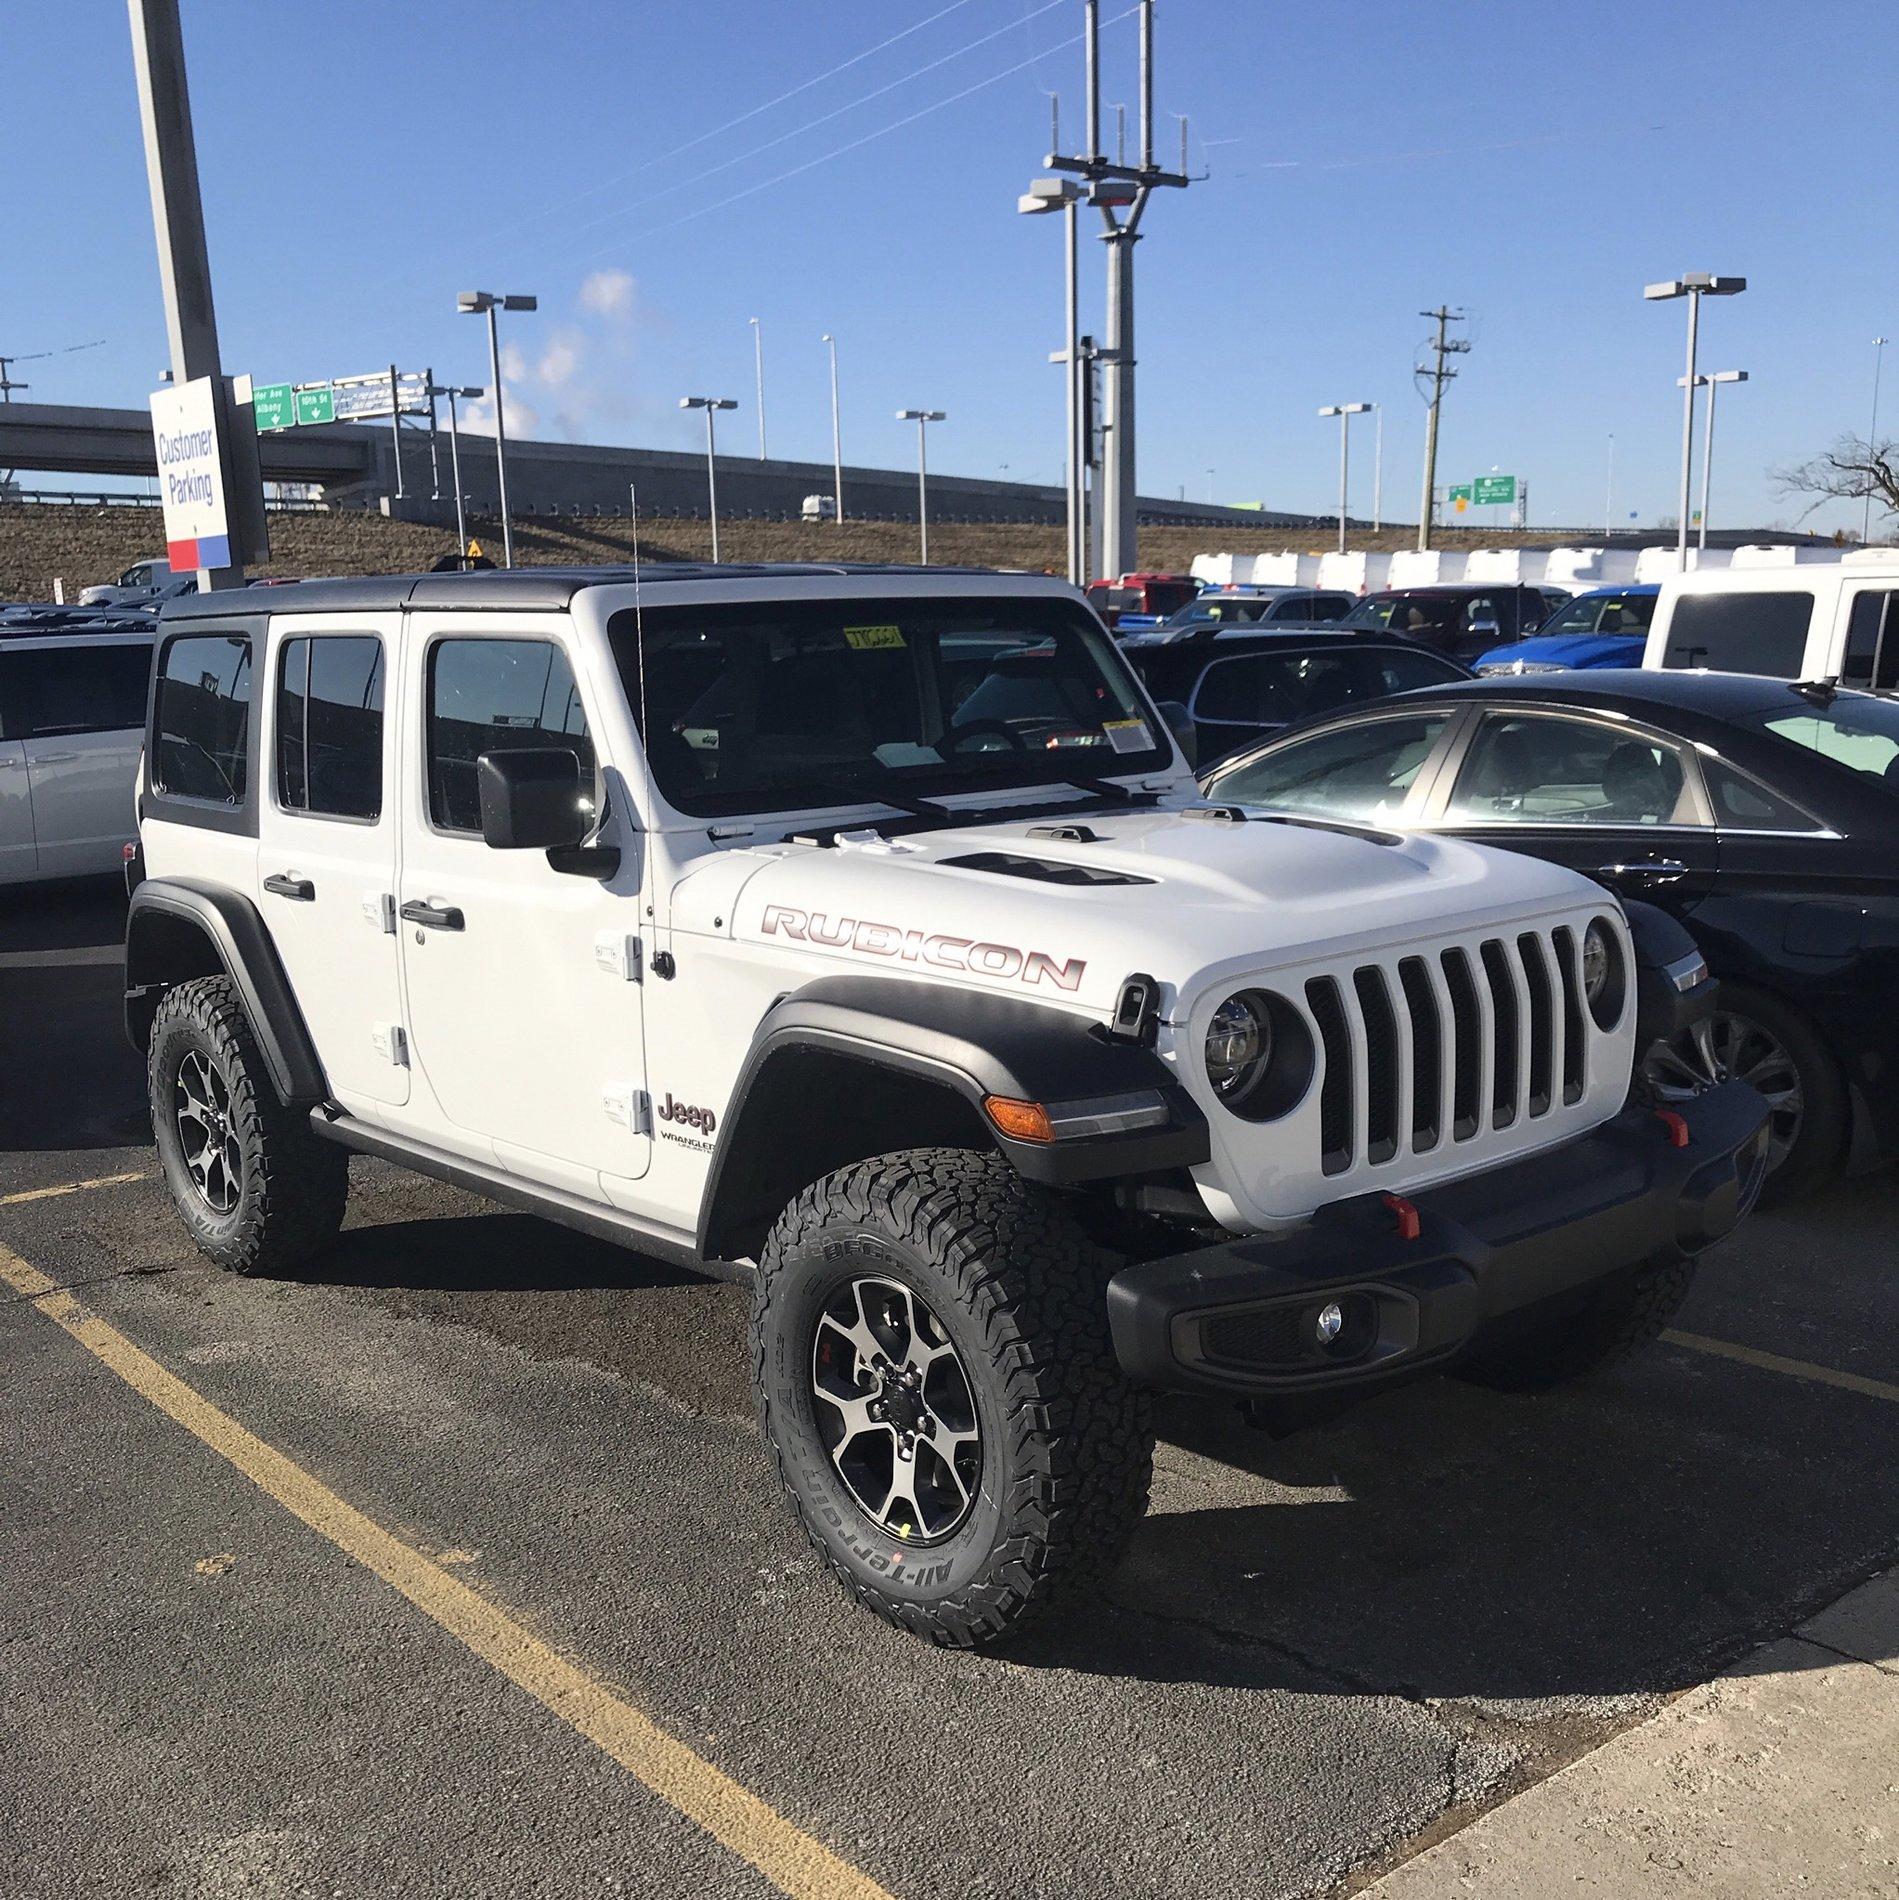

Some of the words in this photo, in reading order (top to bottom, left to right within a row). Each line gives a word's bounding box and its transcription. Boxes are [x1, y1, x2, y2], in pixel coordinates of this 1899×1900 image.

[158, 427, 213, 466] Customer
[168, 469, 213, 508] Parking
[761, 904, 1087, 992] RUBICON
[658, 1092, 716, 1136] Jeep
[660, 1130, 715, 1151] WRANGLER
